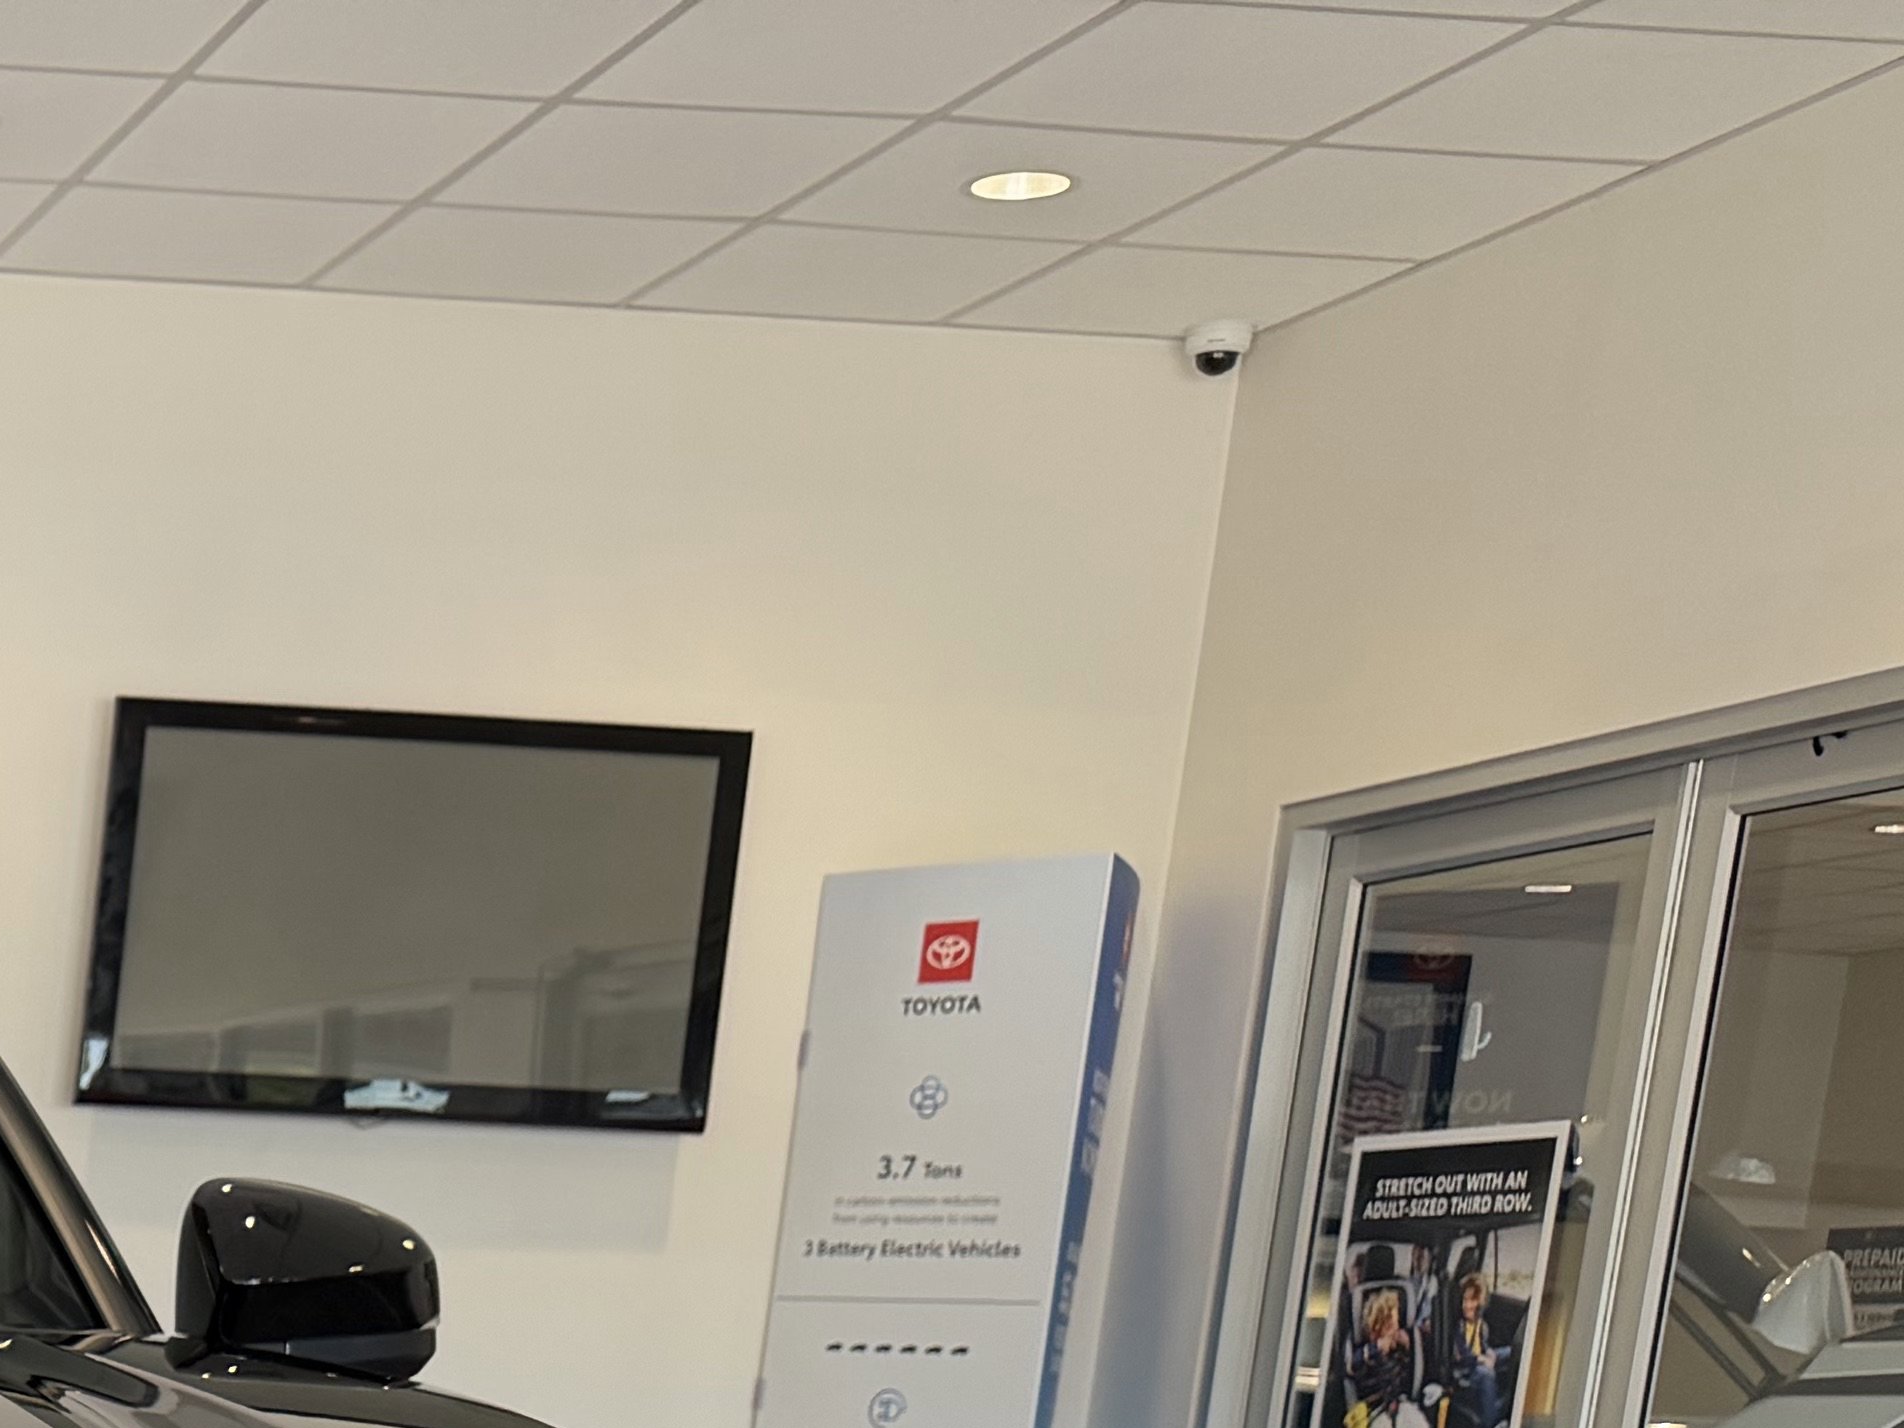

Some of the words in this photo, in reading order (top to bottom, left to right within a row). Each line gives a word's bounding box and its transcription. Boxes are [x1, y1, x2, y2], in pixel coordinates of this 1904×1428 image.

[902, 995, 982, 1016] TOYOTA
[877, 1154, 917, 1180] 3.7
[1375, 1175, 1433, 1198] STRETCH
[1434, 1173, 1464, 1195] OUT
[1466, 1171, 1504, 1192] WITH
[1504, 1170, 1528, 1190] AN
[1362, 1197, 1448, 1220] ADULT-SIZED
[1450, 1195, 1492, 1216] THIRD
[1493, 1192, 1533, 1213] ROW.
[947, 1239, 1021, 1259] Vehicles
